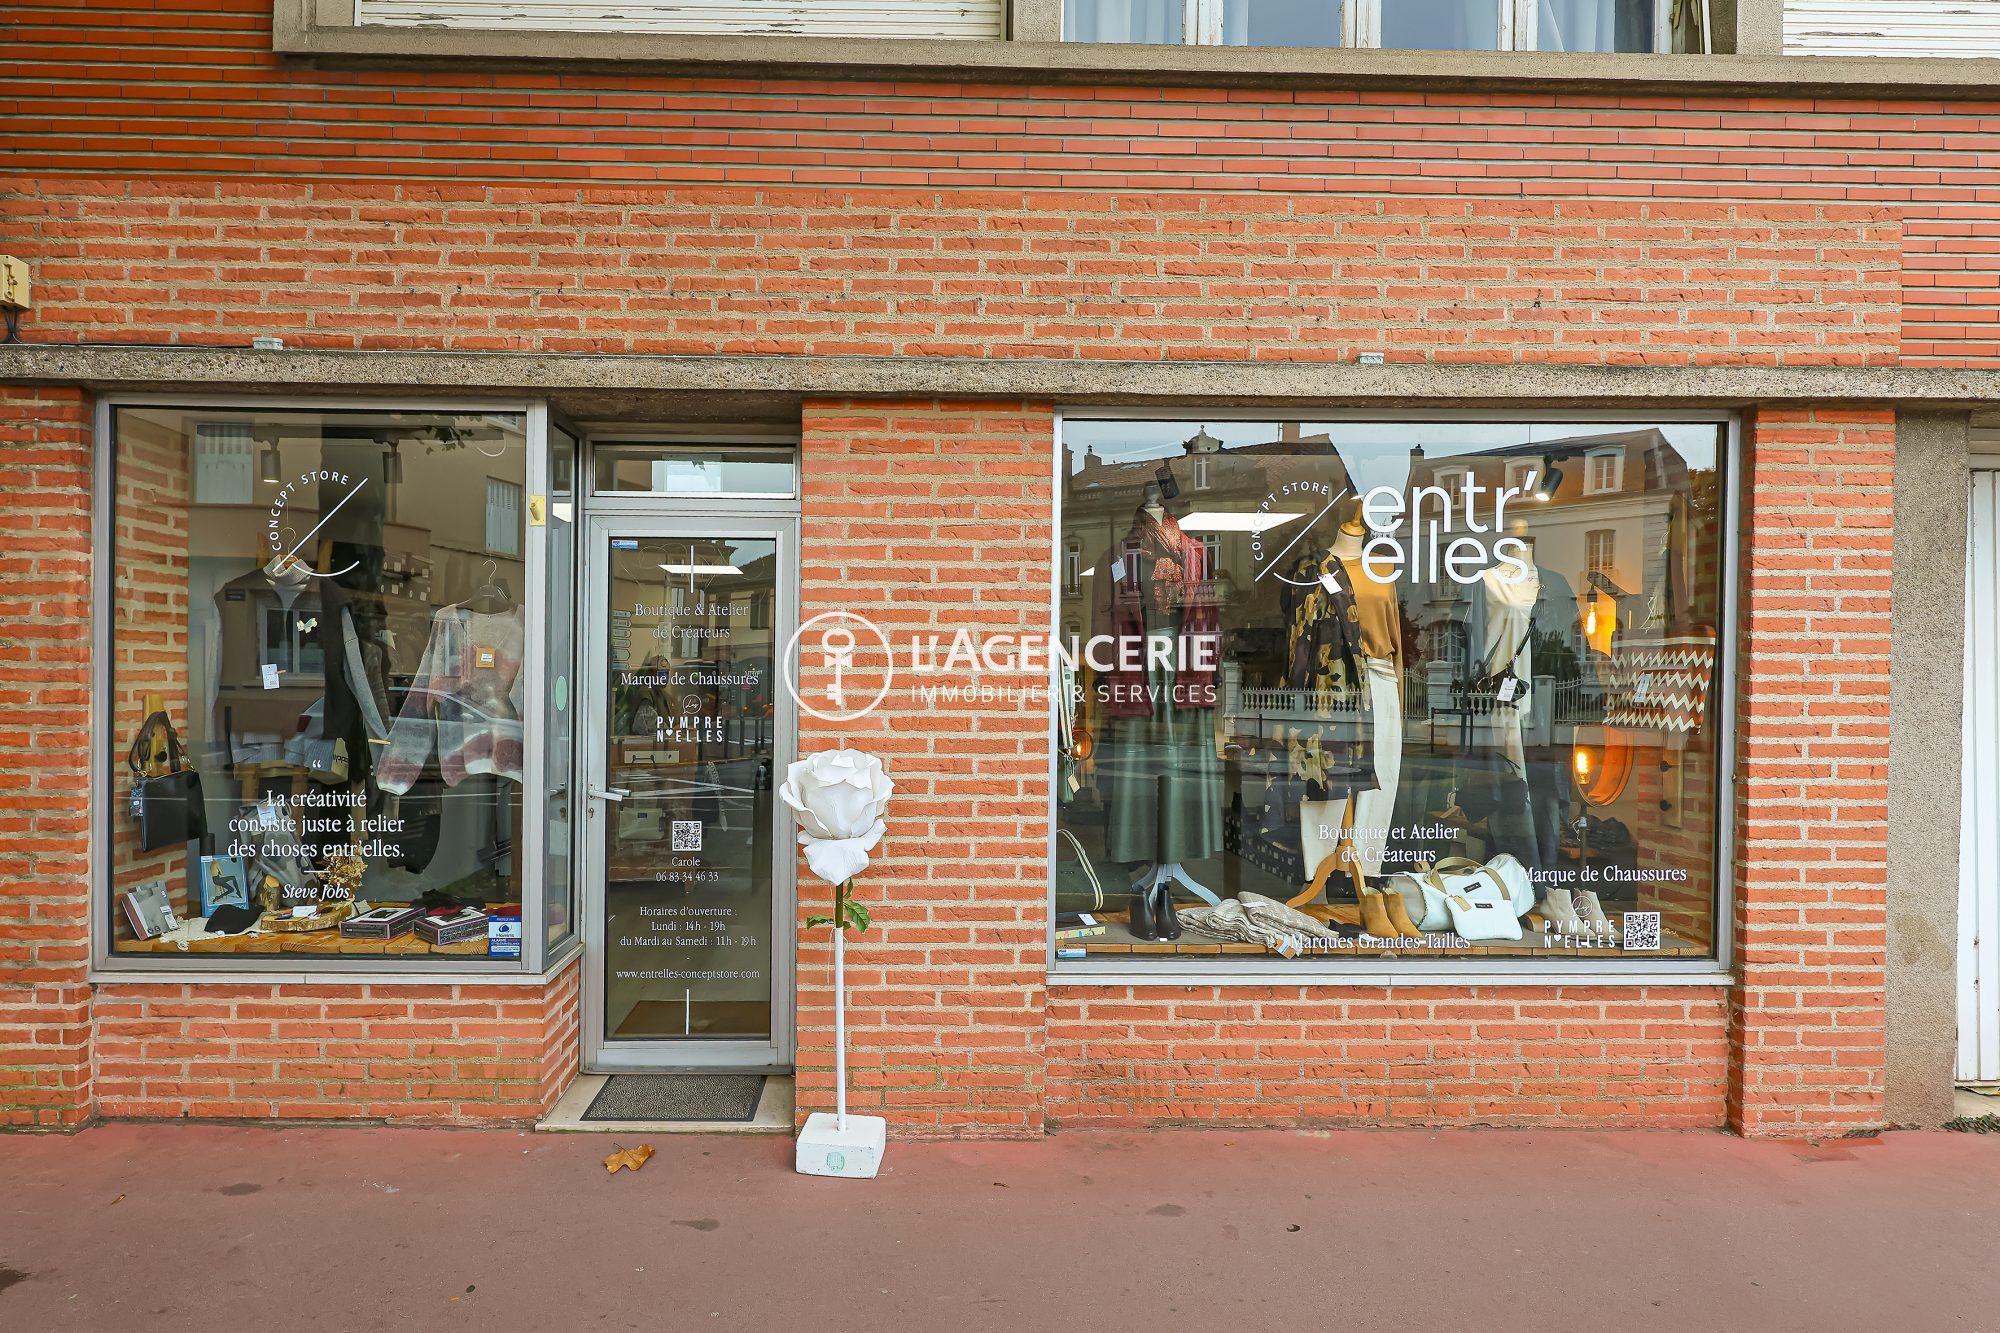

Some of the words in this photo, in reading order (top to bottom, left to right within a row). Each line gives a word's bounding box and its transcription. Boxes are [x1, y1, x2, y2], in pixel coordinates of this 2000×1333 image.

[269, 482, 295, 551] CONCEPT
[301, 470, 349, 485] STORE
[1251, 493, 1277, 560] CONCEPT
[1282, 481, 1329, 495] STORE
[1361, 520, 1529, 584] elles
[634, 603, 691, 620] Boutique
[694, 603, 705, 616] &
[708, 603, 749, 616] Atelier
[653, 625, 668, 638] de
[671, 625, 731, 638] Créateurs
[621, 672, 667, 688] Marque
[670, 672, 685, 685] de
[690, 672, 759, 685] Chaussures
[657, 716, 723, 729] PYMPRE
[266, 790, 286, 807] La
[290, 788, 367, 807] créativité
[228, 815, 297, 832] consiste
[301, 815, 342, 836] juste
[346, 814, 356, 832] à
[359, 814, 405, 832] relier
[1318, 824, 1387, 844] Boutique
[1391, 826, 1406, 840] et
[1410, 823, 1460, 840] Atelier
[228, 839, 256, 857] des
[261, 839, 318, 857] choses
[1341, 846, 1360, 862] de
[1364, 846, 1436, 862] Créateurs
[671, 857, 701, 867] Carole
[656, 872, 667, 882] 06
[695, 872, 706, 882] 46
[708, 872, 719, 882] 33
[1521, 867, 1576, 886] Marque
[1580, 866, 1599, 881] de
[1603, 865, 1687, 882] Chaussures
[282, 884, 318, 899] Steve
[319, 884, 350, 901] Jobs
[640, 907, 677, 916] Horaires
[651, 921, 677, 931] Lundi
[1544, 920, 1615, 933] PYMPRE
[620, 936, 632, 946] du
[634, 936, 660, 946] Mardi
[662, 938, 673, 946] au
[675, 936, 708, 946] Samedi
[1290, 933, 1354, 952] Marques
[616, 969, 760, 980] www.entrelles-conceptstore.com
